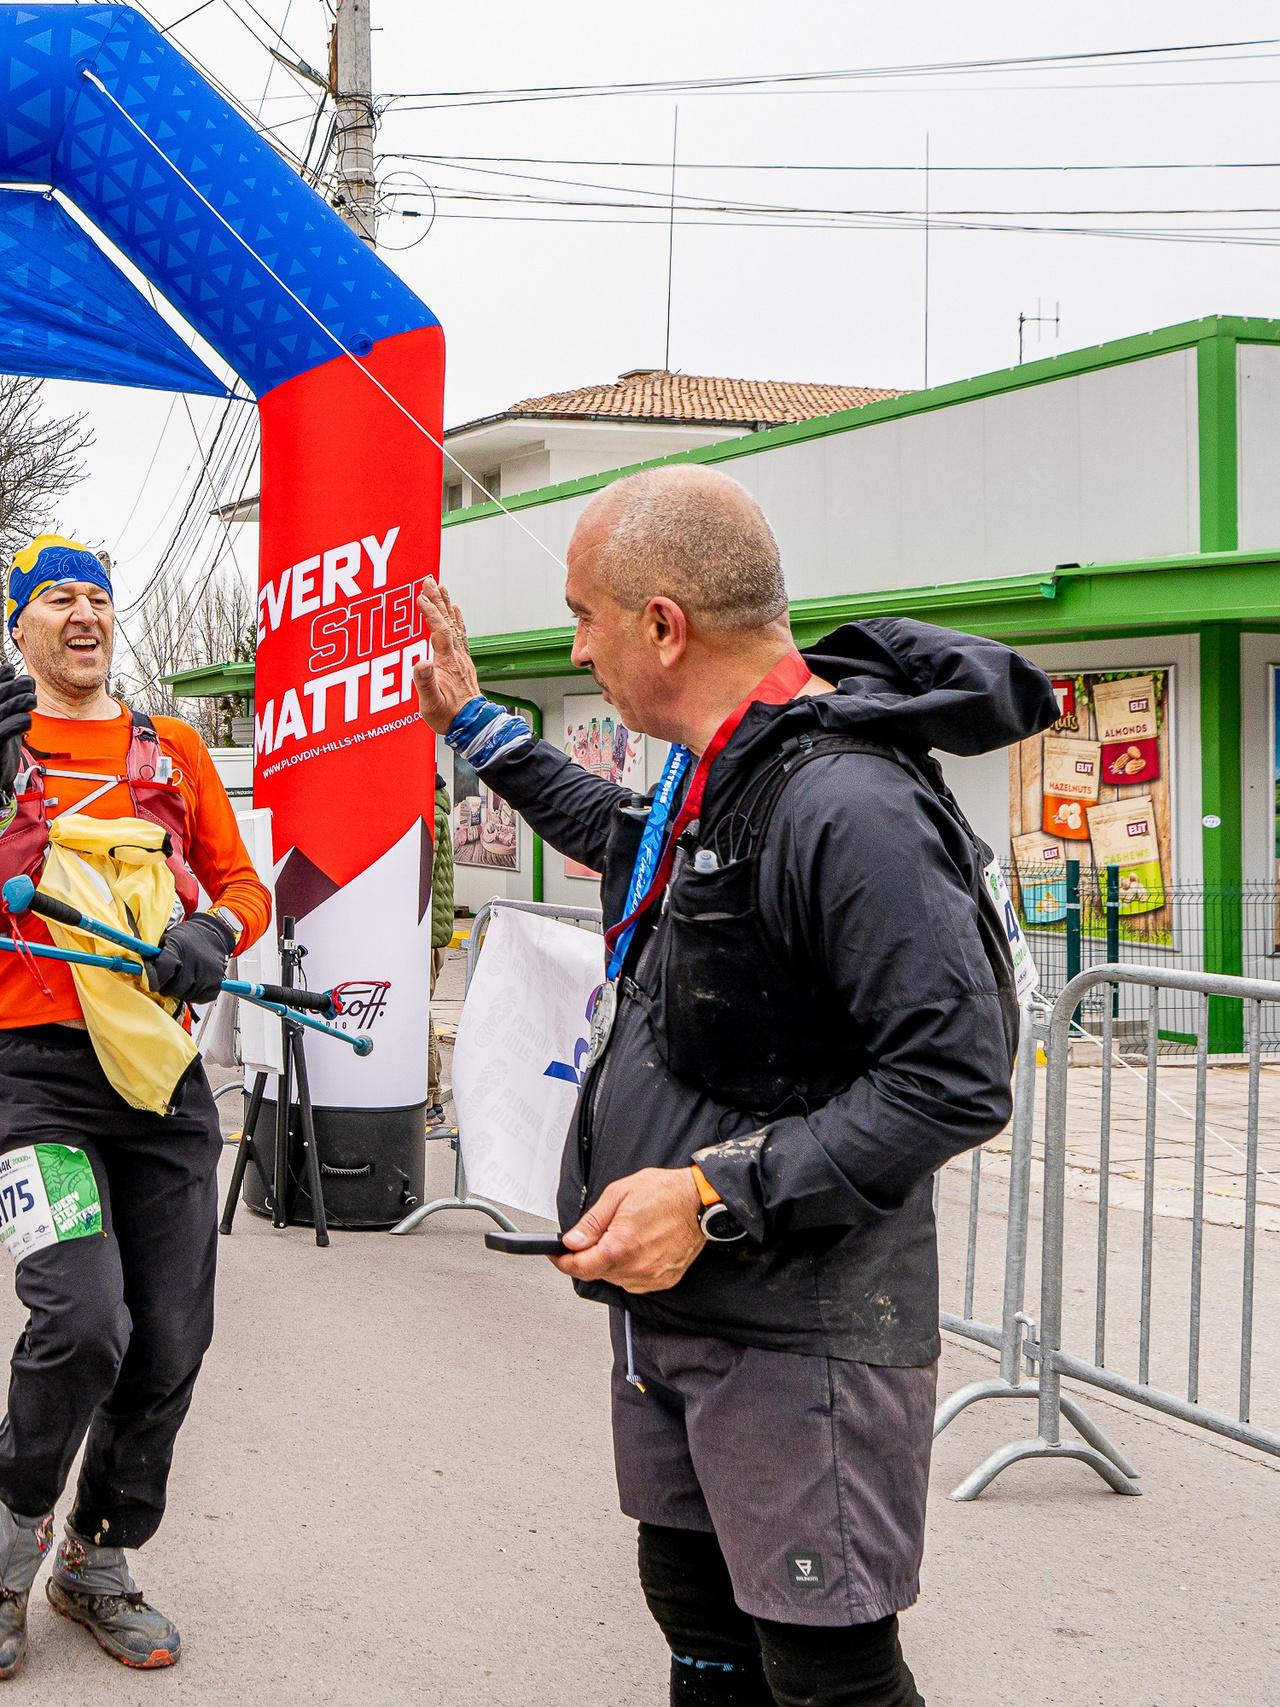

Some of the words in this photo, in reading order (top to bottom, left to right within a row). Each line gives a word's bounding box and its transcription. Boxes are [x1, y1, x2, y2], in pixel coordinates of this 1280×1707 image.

[256, 526, 401, 649] EVERY
[254, 638, 434, 769] MATTER
[1105, 724, 1148, 738] ALMONDS
[1049, 782, 1092, 795] HAZELNUTS
[1103, 849, 1151, 865] CASHEWS
